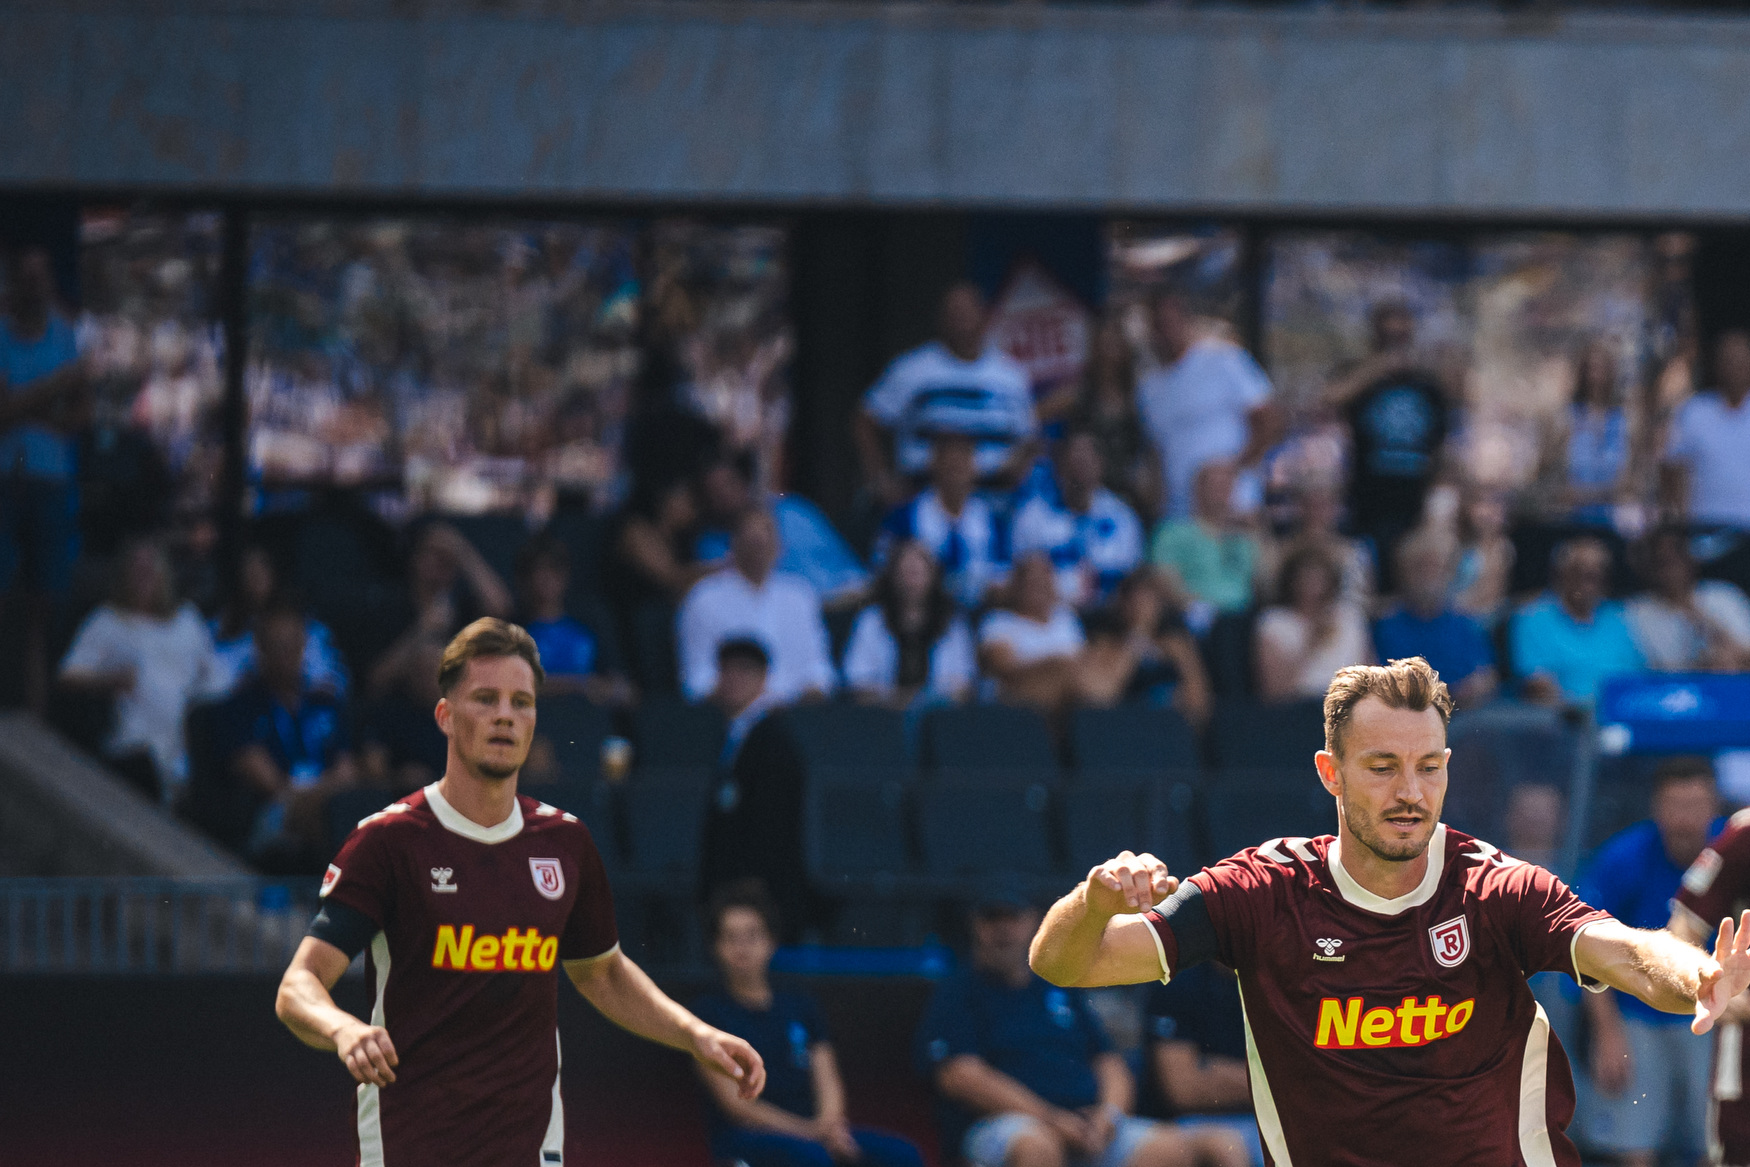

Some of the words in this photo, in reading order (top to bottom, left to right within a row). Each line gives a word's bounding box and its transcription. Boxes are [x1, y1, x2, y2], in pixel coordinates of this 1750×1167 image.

[432, 923, 559, 972] Netto
[1313, 953, 1346, 963] hummel
[1315, 996, 1475, 1047] Netto
